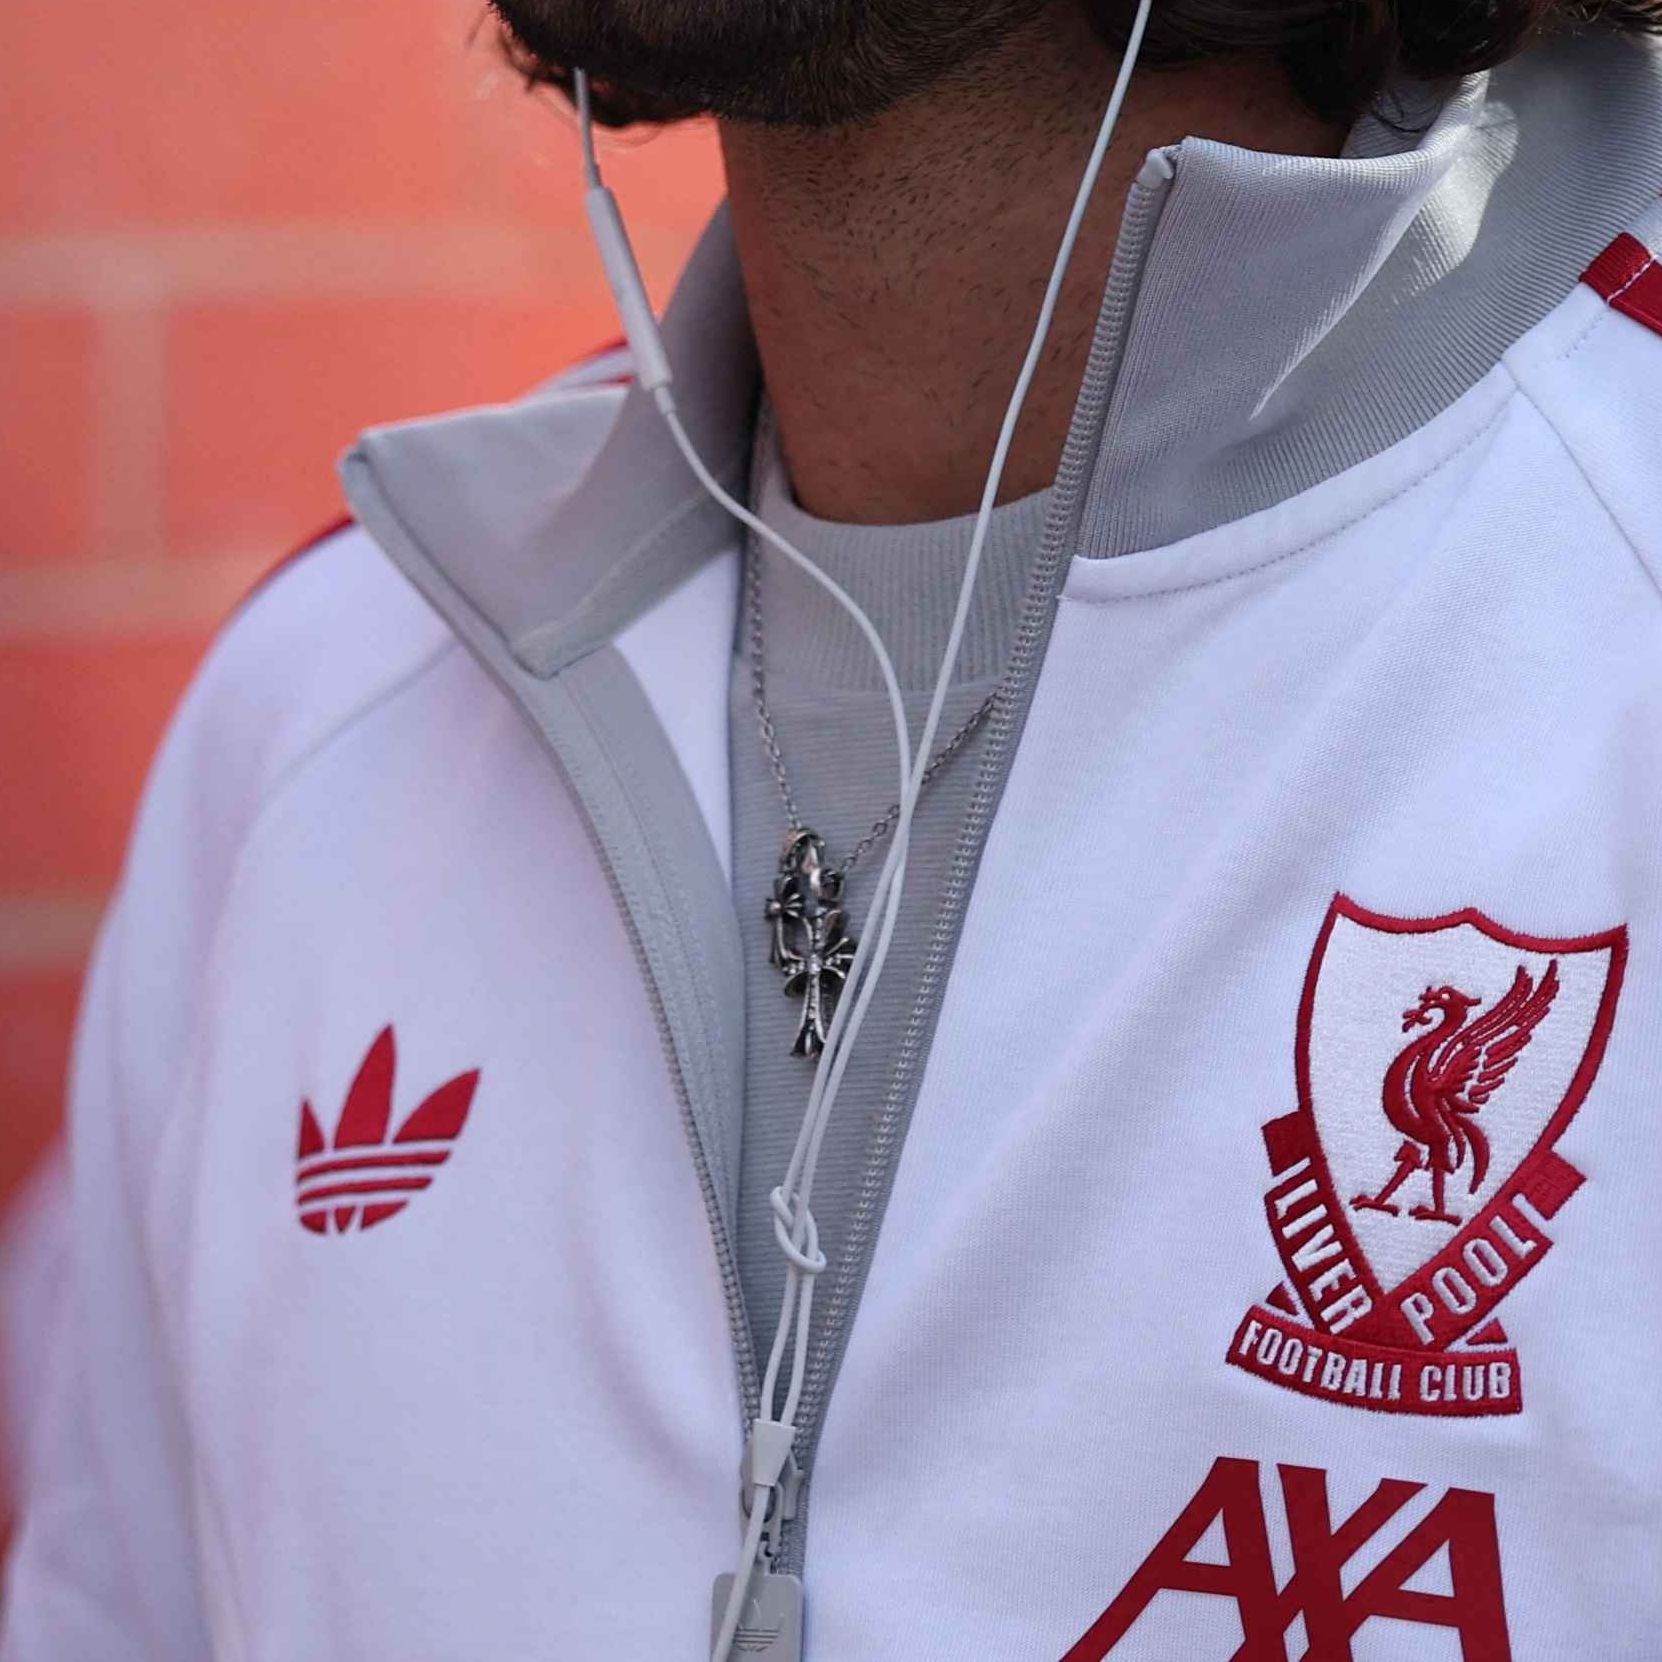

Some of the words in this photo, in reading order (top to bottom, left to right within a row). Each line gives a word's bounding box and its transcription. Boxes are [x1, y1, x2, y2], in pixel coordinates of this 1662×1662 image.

[1274, 1178, 1374, 1336] LIVER
[1400, 1214, 1538, 1345] POOL
[1238, 1319, 1403, 1402] FOOTBALL
[1418, 1361, 1512, 1402] CLUB
[1057, 1455, 1513, 1662] AXA
